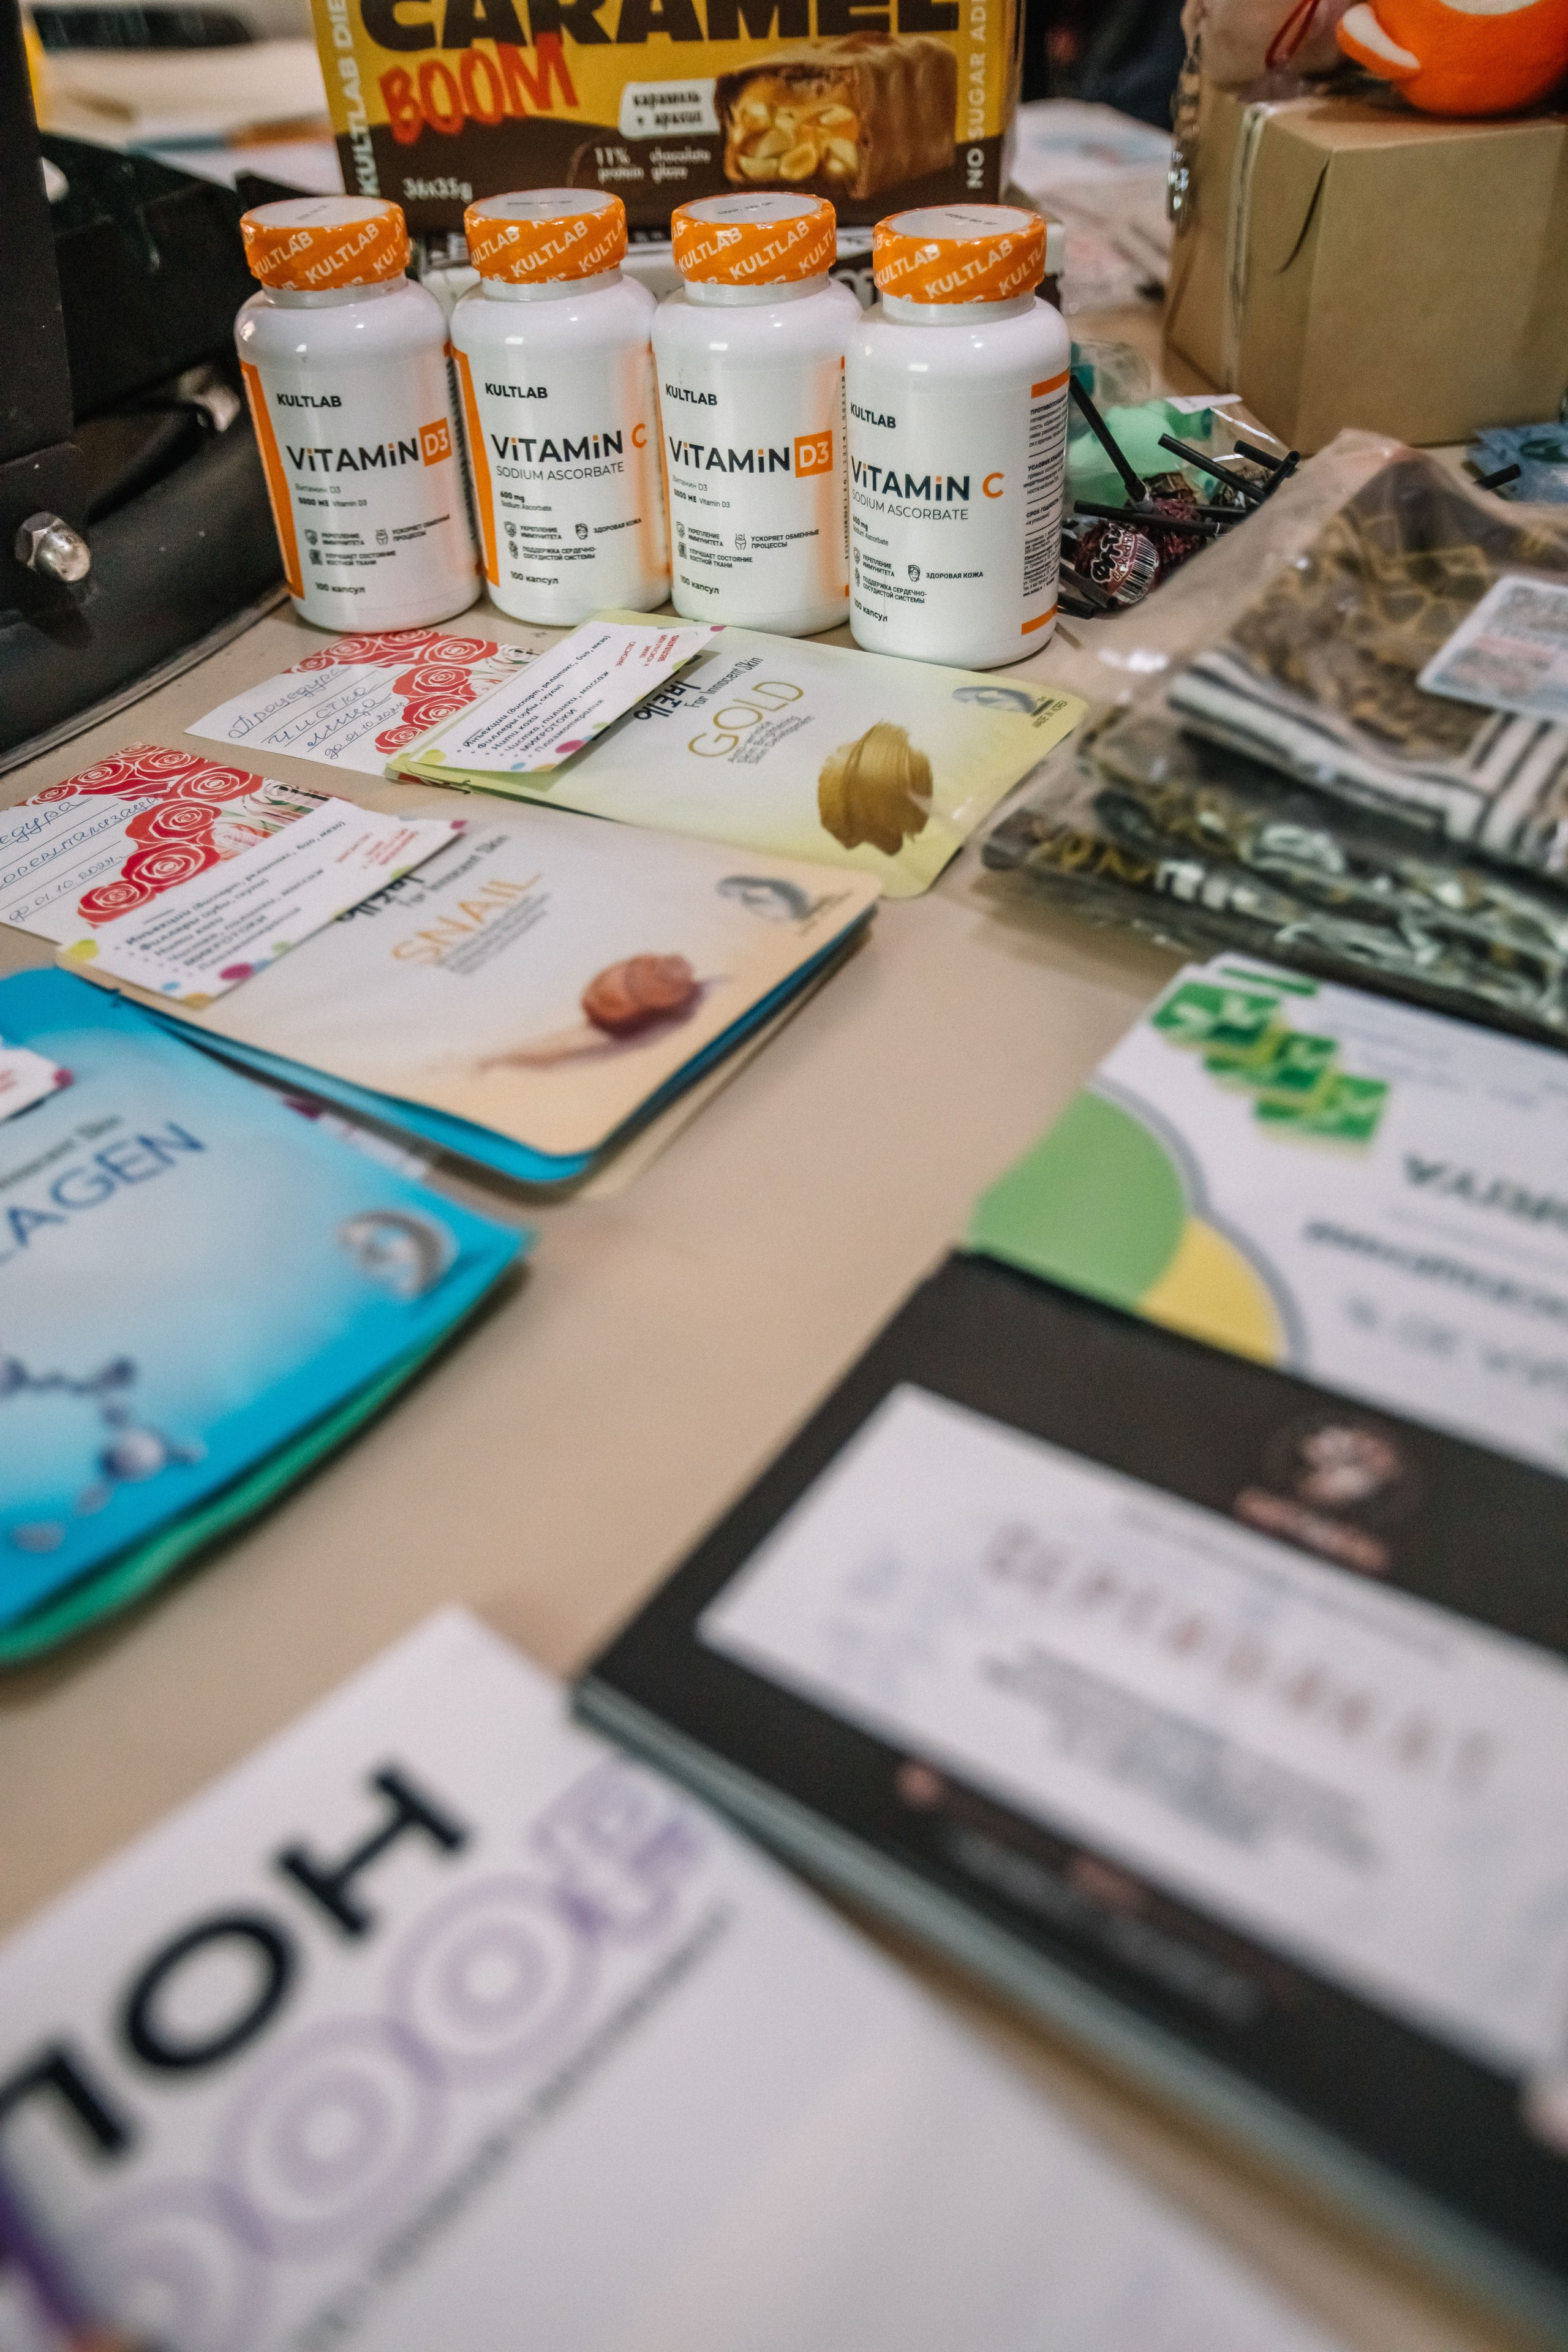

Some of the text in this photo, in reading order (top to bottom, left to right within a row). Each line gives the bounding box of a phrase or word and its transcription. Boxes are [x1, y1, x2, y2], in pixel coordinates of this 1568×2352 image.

[379, 32, 579, 145] BOOM
[967, 53, 986, 140] SUGAR
[966, 148, 985, 189] NO
[253, 231, 314, 277] KULTLAB
[304, 223, 379, 284] KULTLAB
[510, 221, 589, 278] KULTLAB
[578, 217, 624, 273] KULTLA
[679, 227, 742, 273] KULTLAB
[729, 221, 810, 281] KULTLAB
[876, 244, 940, 287] KULTLAB
[924, 239, 1013, 300] KULTLAB
[276, 393, 342, 407] KULTLAB
[485, 383, 548, 399] KULTLAB
[665, 383, 717, 406] KULTLAB
[850, 402, 896, 429] KULTLAB
[424, 428, 449, 456] D3
[631, 423, 647, 448] C
[799, 440, 830, 469] D3
[496, 461, 625, 481] SODIUM ASCORBATE
[698, 483, 708, 491] D3
[982, 472, 1005, 499] C
[699, 497, 720, 507] Vitamin
[852, 488, 969, 521] SODIUM ASCORBATE
[594, 522, 625, 533] ЗДОРОВАЯ
[688, 527, 720, 540] УКРЕПЛЕНИЕ
[751, 528, 820, 543] УСКОРЯЕТ ОБМЕННЫЕ
[861, 521, 869, 532] mg
[688, 534, 723, 547] ИММУНИТЕТА
[751, 541, 788, 549] ПРОЦЕССЫ
[865, 532, 889, 546] Ascorbate
[690, 555, 712, 565] КОСТНОЙ
[862, 554, 892, 570] УКРЕПЛЕНИЕ
[862, 561, 895, 578] ИММУНИТЕТА
[510, 571, 559, 585] 100 капсул
[680, 574, 720, 595] 100 капсул
[862, 575, 927, 597] ПОДДЕРЖКА СЕРДЕЧНО-
[925, 570, 984, 580] ЗДОРОВАЯ КОЖА
[862, 582, 925, 604] СОСУДИСТОЙ СИСТЕМЫ
[862, 605, 888, 622] капсул
[463, 714, 508, 747] Инъекции
[592, 635, 611, 649] мезо)
[580, 671, 609, 695] массаж
[684, 657, 764, 708] For Innocent Skin
[478, 719, 518, 748] Филлеры
[540, 684, 564, 704] скулы)
[688, 680, 804, 758] GOLD
[491, 731, 519, 750] Нити
[520, 709, 577, 752] МИКРОТОКИ
[390, 872, 543, 966] SNAIL
